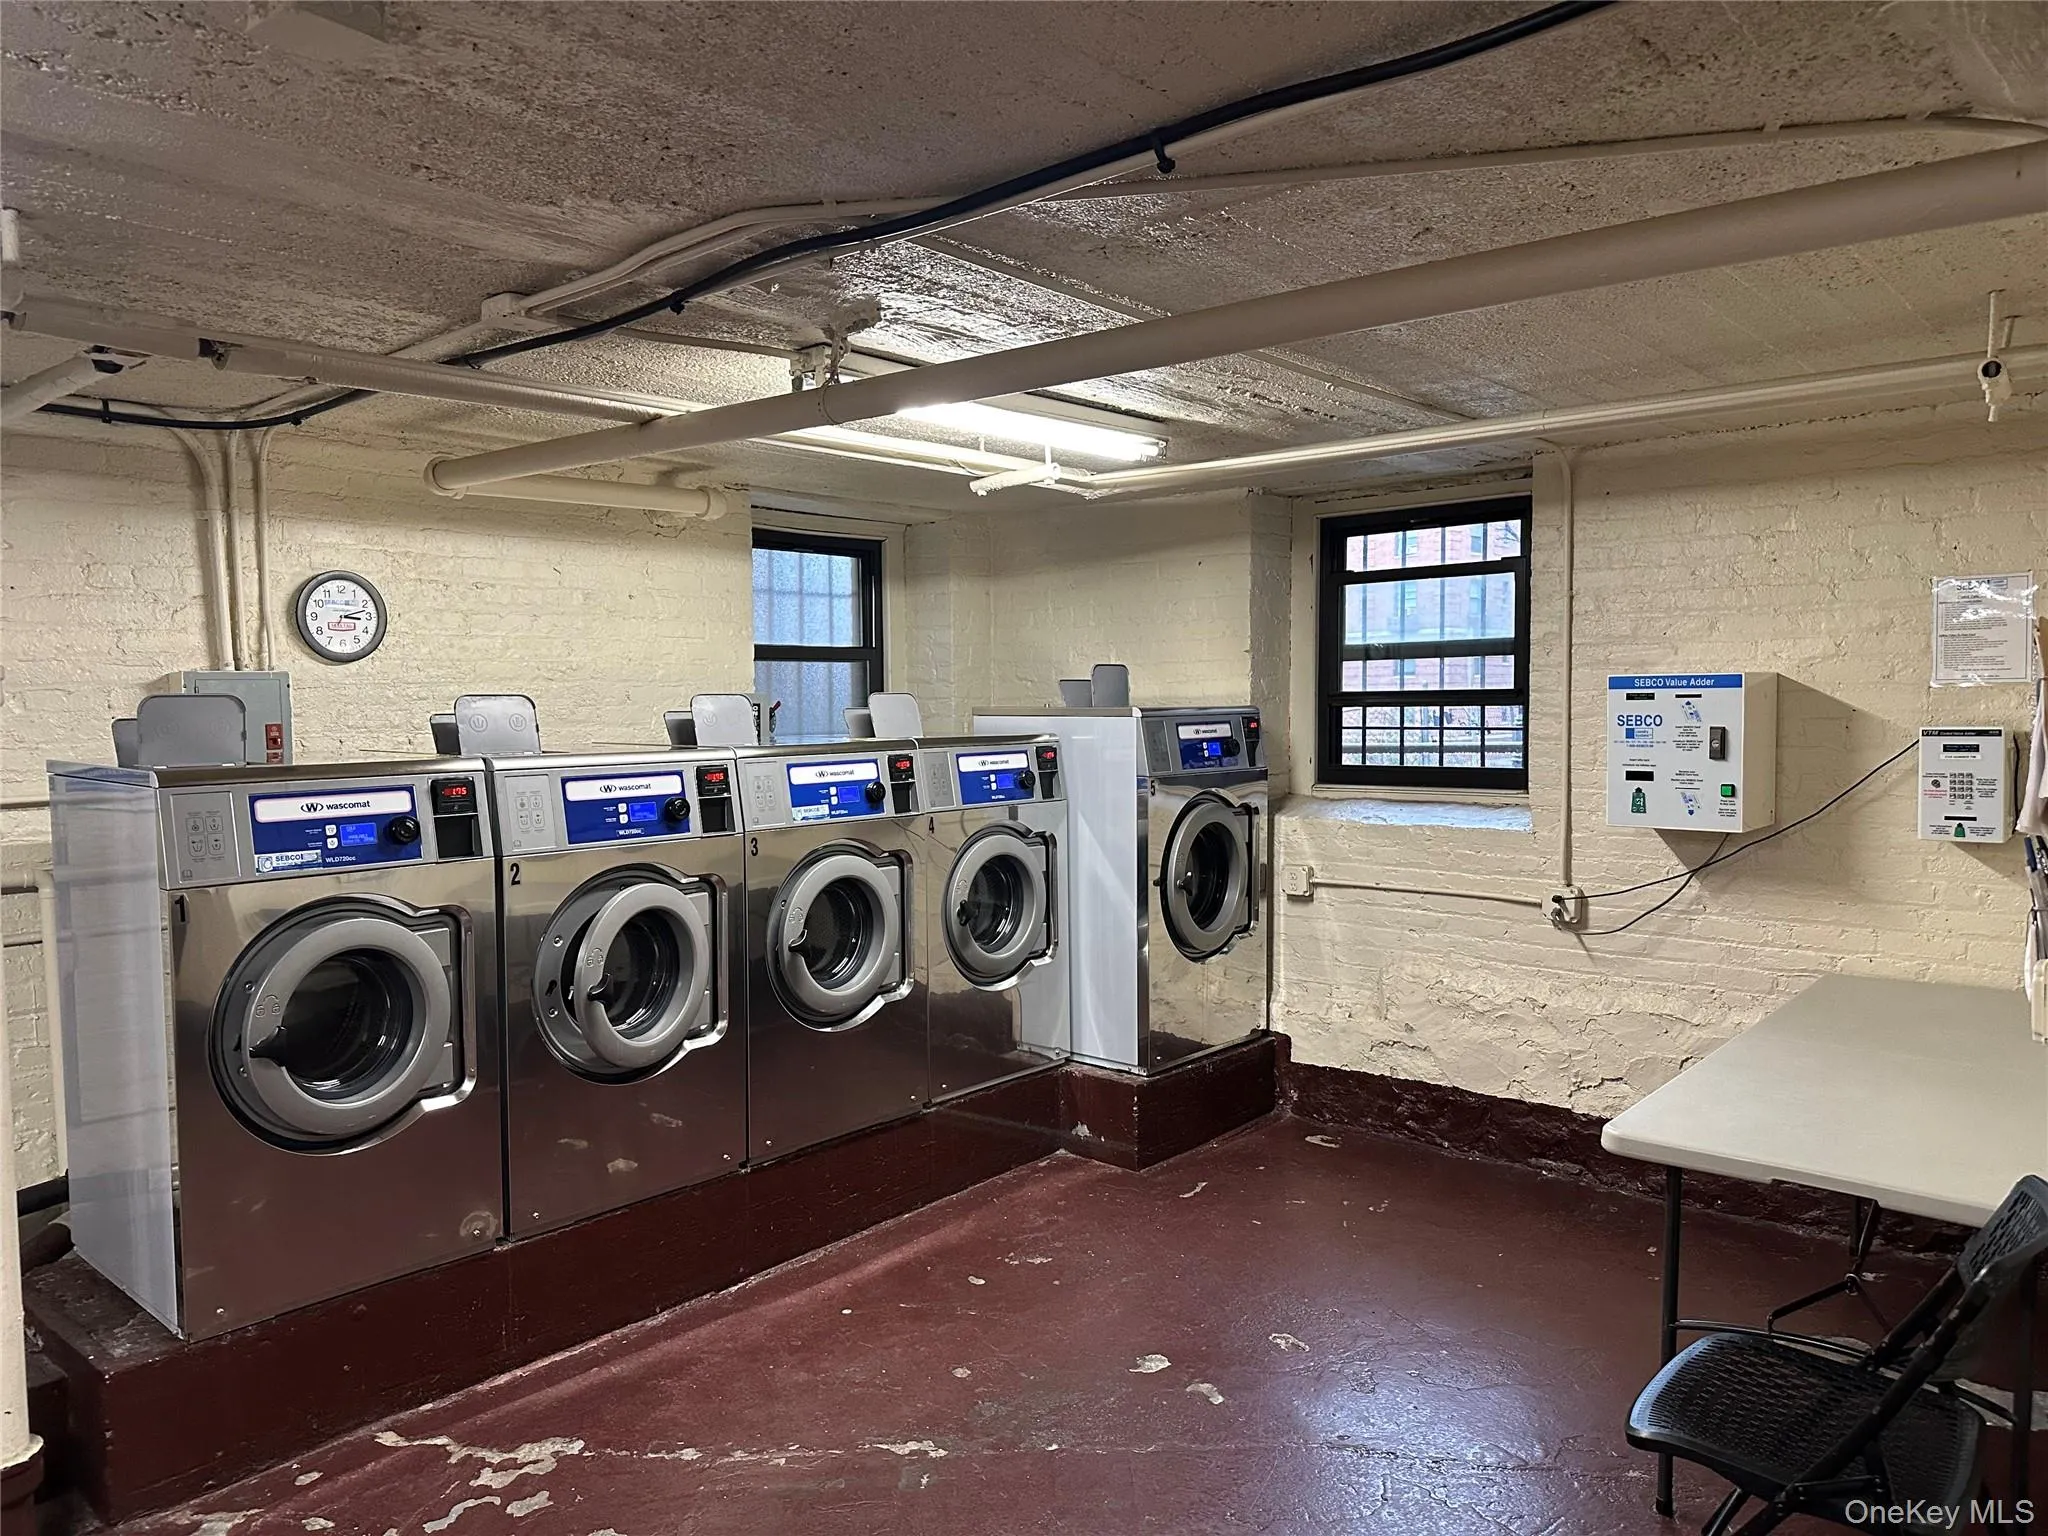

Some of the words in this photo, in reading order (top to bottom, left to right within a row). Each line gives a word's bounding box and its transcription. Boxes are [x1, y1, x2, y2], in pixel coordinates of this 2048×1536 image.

[323, 589, 331, 598] 11
[336, 585, 346, 594] 12
[313, 599, 324, 609] 10
[362, 599, 369, 609] 2
[310, 612, 318, 621] 9
[365, 612, 372, 621] 3
[316, 626, 323, 636] 8
[362, 626, 369, 635] 4
[326, 636, 333, 645] 7
[339, 639, 347, 648] 6
[354, 635, 361, 645] 5
[1634, 678, 1664, 687] SEBCO
[1666, 678, 1688, 687] Value
[1690, 677, 1715, 686] Adder
[1617, 714, 1663, 727] SEBCO
[618, 783, 652, 792] wascomat
[1150, 779, 1156, 797] 5
[326, 799, 371, 811] wascomat
[928, 816, 935, 834] 4
[750, 837, 759, 857] 3
[275, 854, 301, 863] SEBCO
[510, 862, 521, 886] 2
[175, 896, 186, 922] 1
